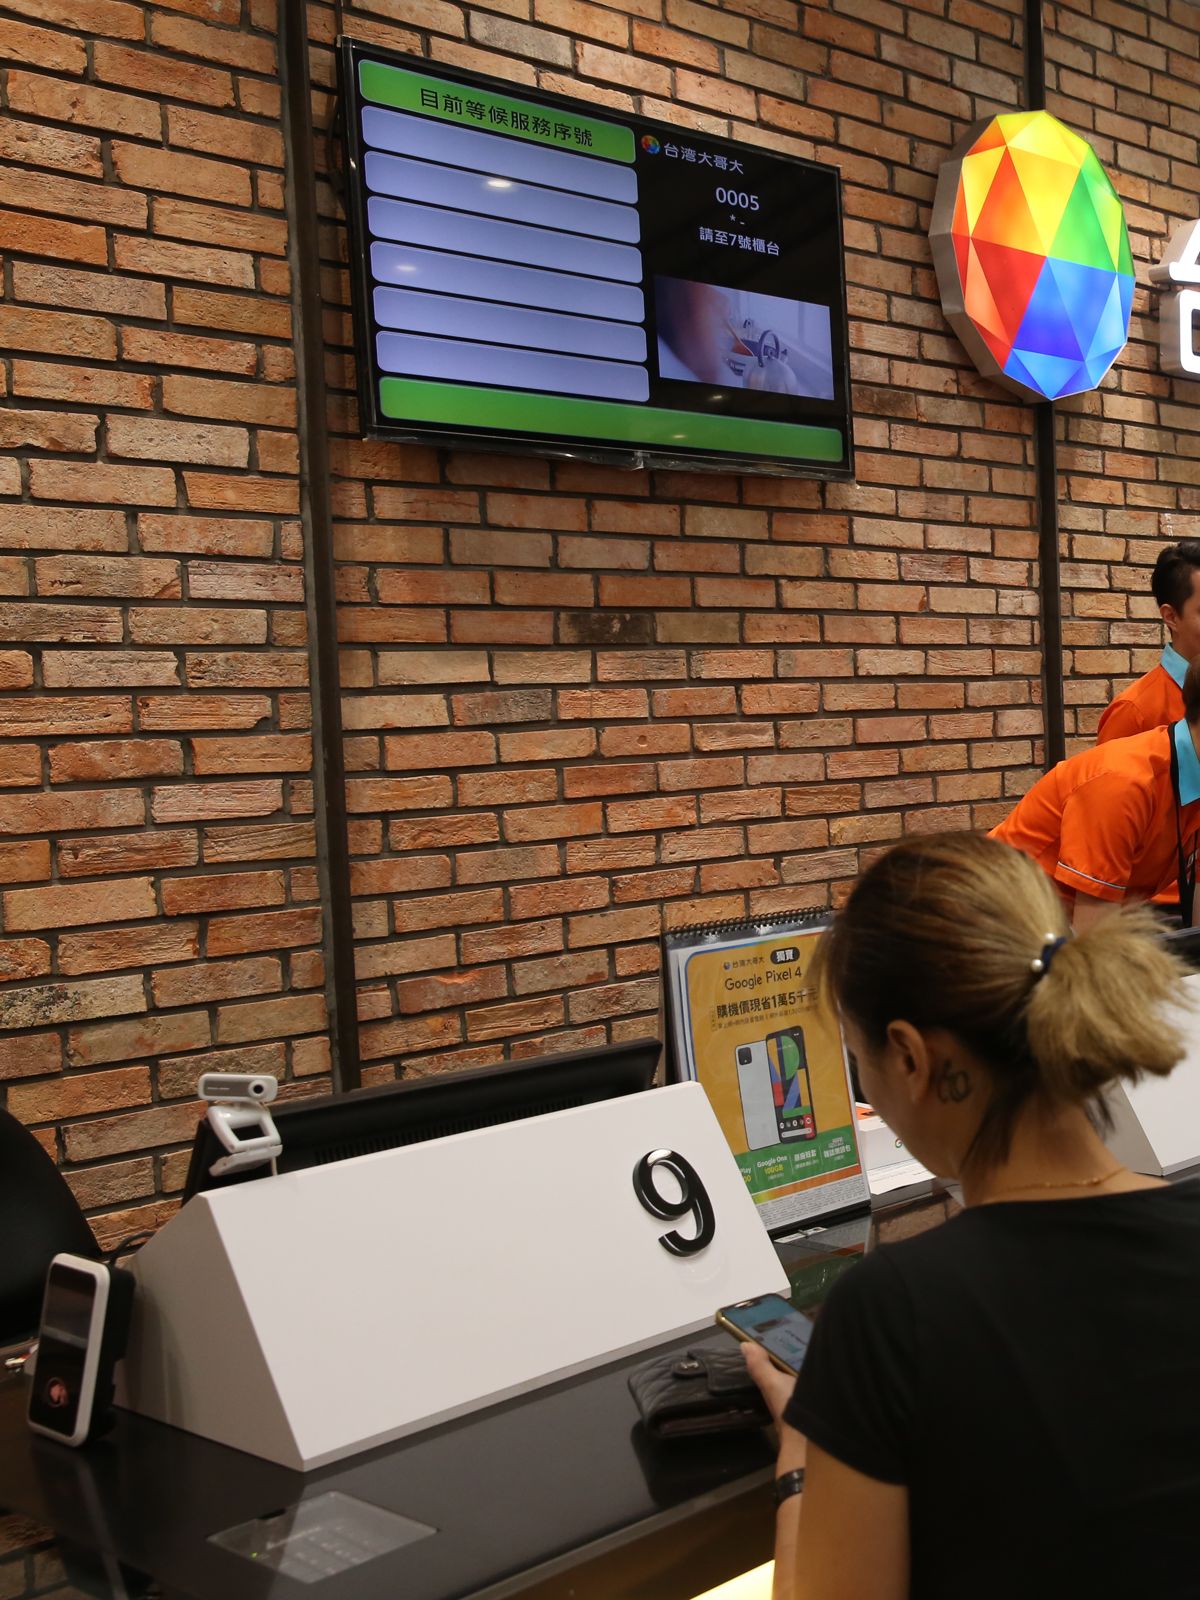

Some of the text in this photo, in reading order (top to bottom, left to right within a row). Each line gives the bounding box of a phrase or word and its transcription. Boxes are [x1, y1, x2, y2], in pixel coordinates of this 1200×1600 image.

[420, 87, 594, 148] 目前等候服務序號
[715, 186, 760, 212] 0005
[699, 226, 780, 256] 請至7號櫃台
[724, 966, 802, 991] Google Pixel 4
[756, 1157, 776, 1169] Google
[632, 1148, 716, 1258] 9
